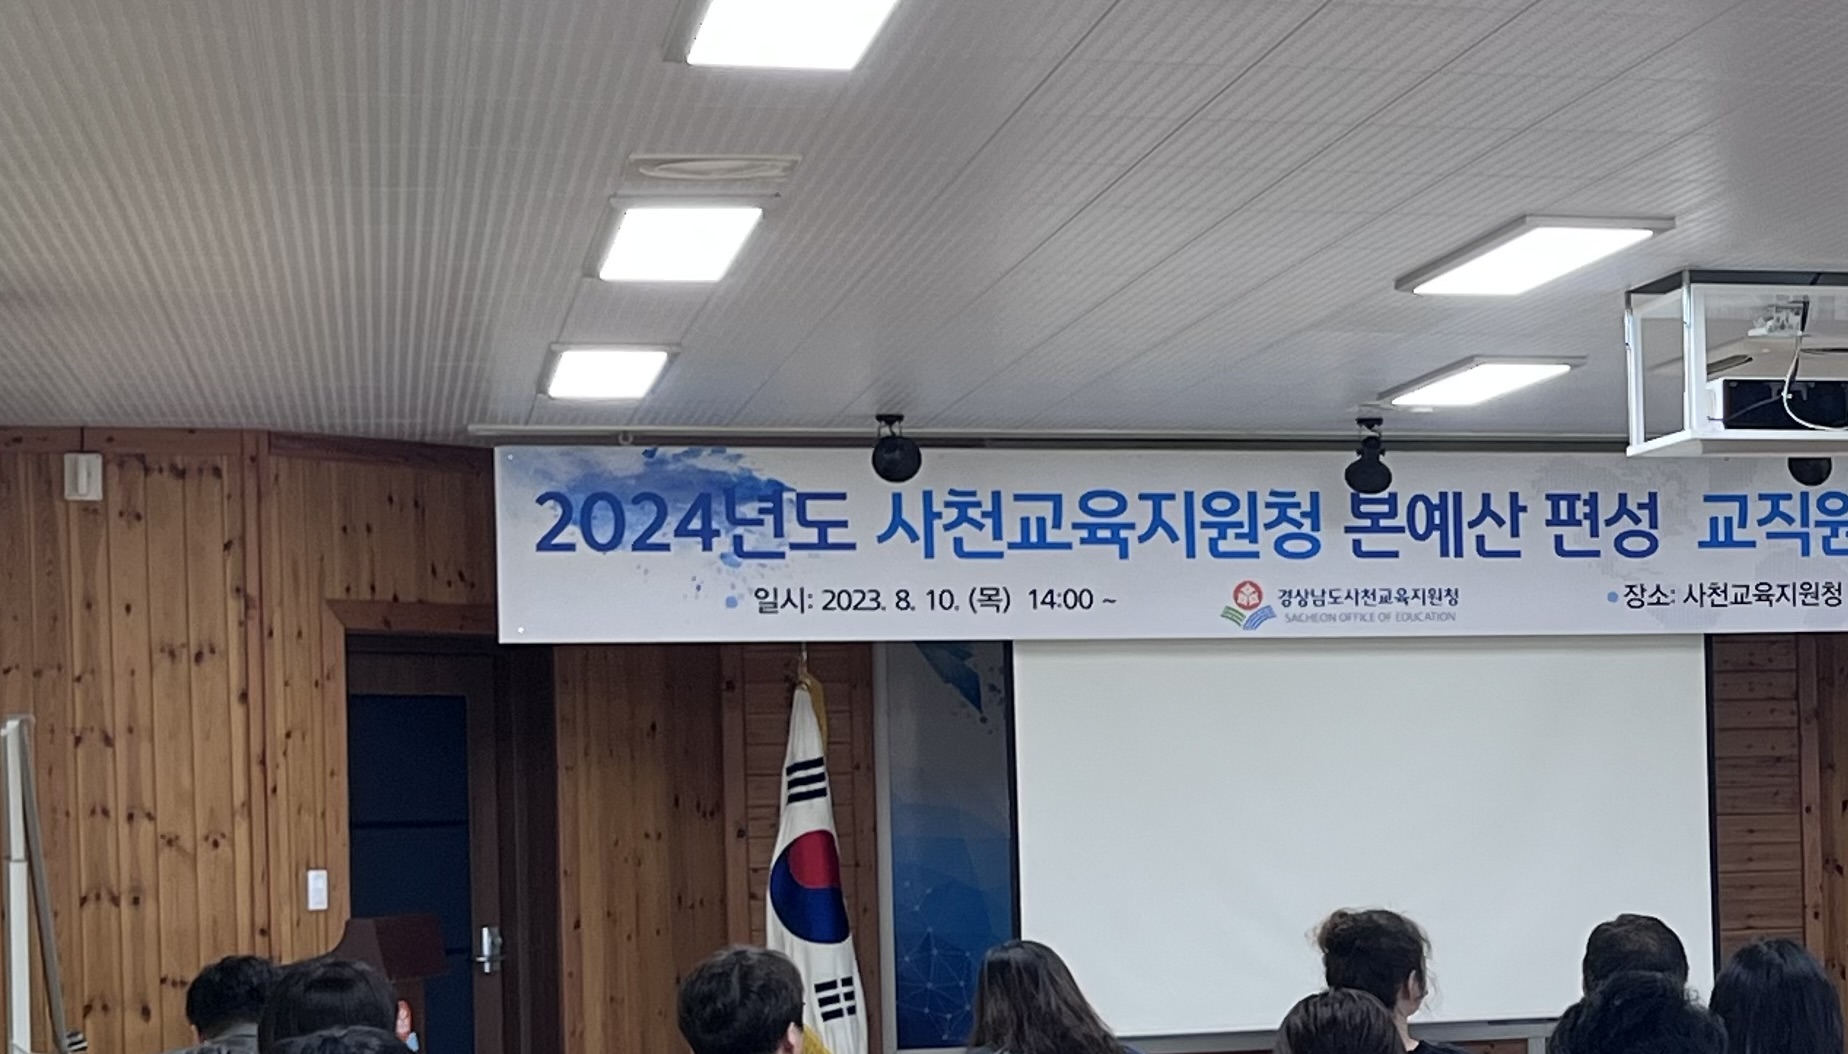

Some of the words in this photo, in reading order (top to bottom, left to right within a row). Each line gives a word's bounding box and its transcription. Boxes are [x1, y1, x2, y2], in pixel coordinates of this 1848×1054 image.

[535, 489, 858, 560] 2024년도
[876, 488, 1322, 560] 사천교육지원청
[1343, 490, 1528, 559] 본예산
[1544, 490, 1661, 559] 편성
[753, 586, 815, 614] 일시:
[821, 588, 887, 614] 2023.
[894, 588, 917, 613] 8.
[926, 588, 960, 613] 10.
[967, 586, 1012, 614] (목)
[1028, 587, 1095, 611] 14:00
[1278, 587, 1460, 608] 경상남도사천교육지원청
[1623, 582, 1677, 609] 장소:
[1682, 581, 1843, 608] 사천교육지원청
[1395, 611, 1457, 623] EDUCATION
